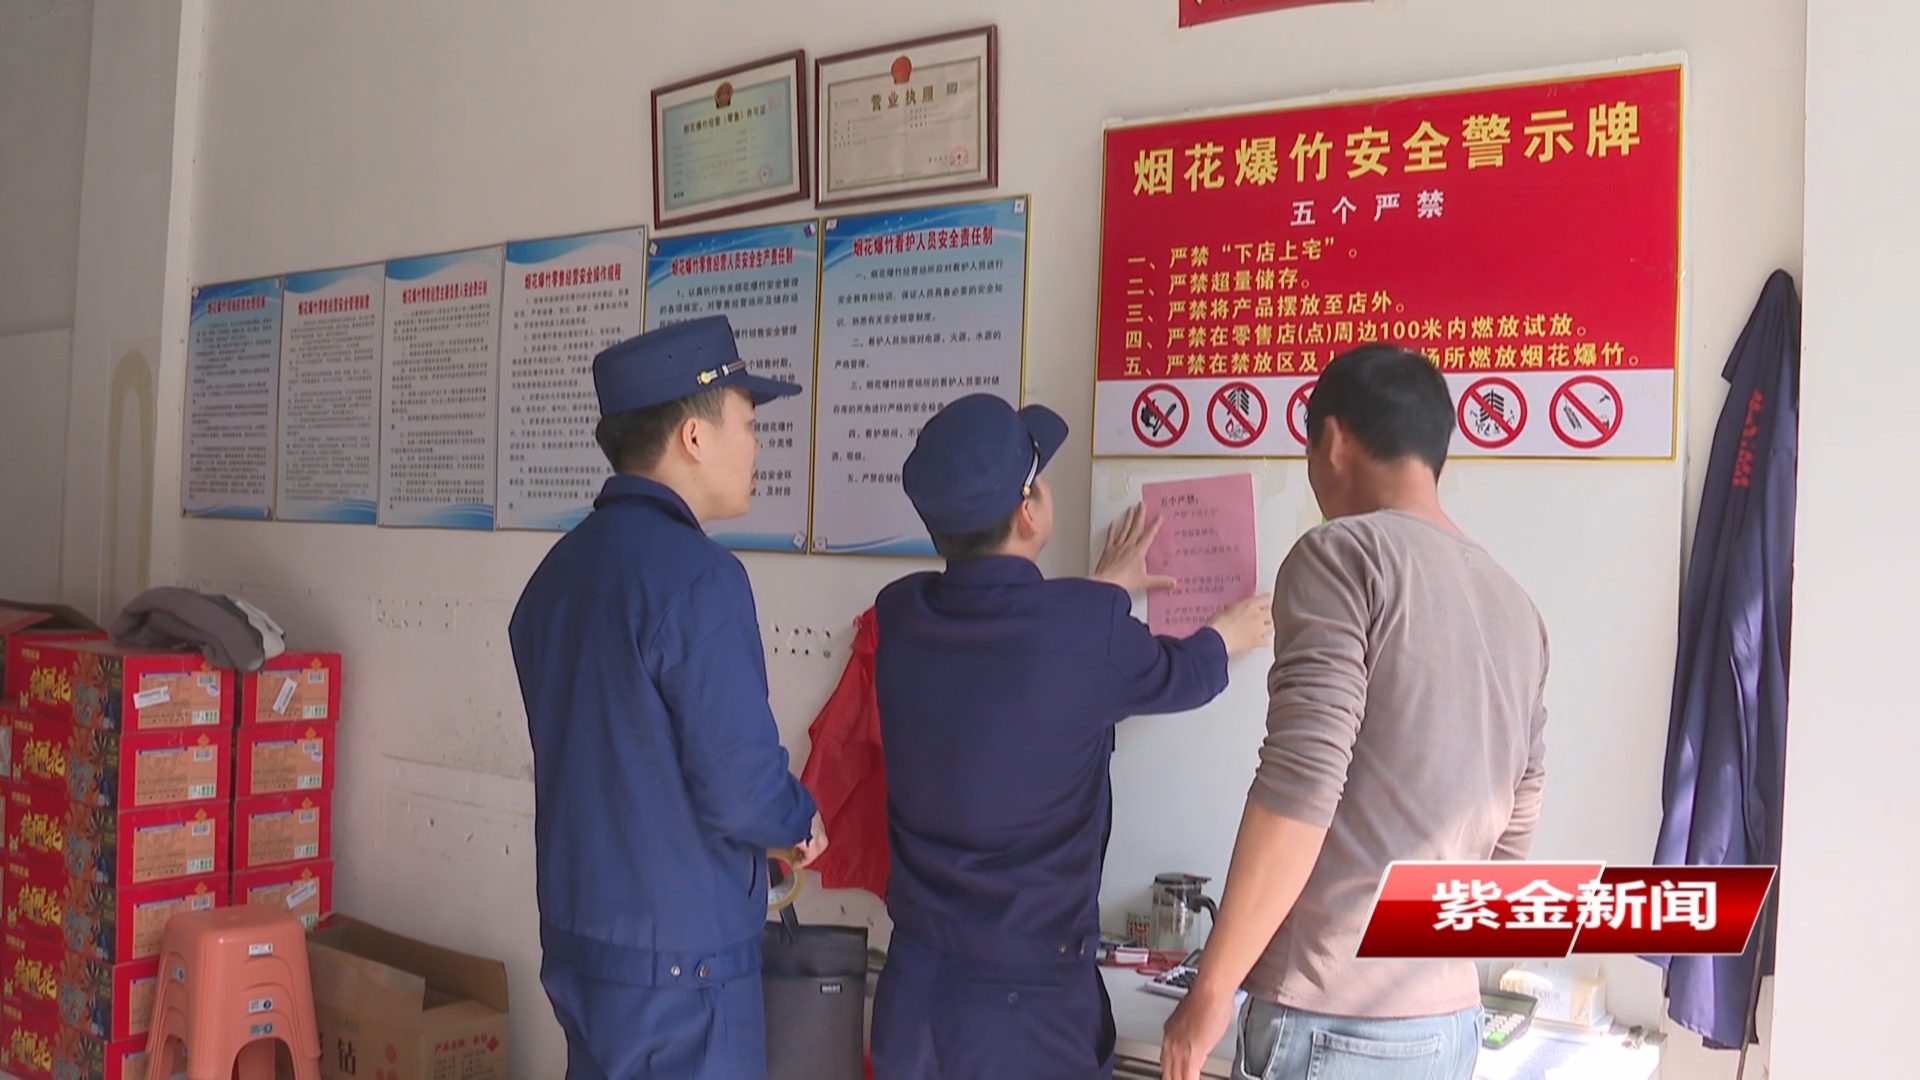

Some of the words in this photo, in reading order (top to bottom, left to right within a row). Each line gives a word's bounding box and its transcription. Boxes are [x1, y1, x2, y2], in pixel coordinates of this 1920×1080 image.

[871, 85, 934, 112] 营业执照
[1132, 101, 1641, 197] 烟花爆竹安全警示牌
[1289, 189, 1445, 227] 五个严禁
[853, 225, 994, 257] 烟花爆竹看护人员安全责任制
[671, 246, 794, 277] 烟花爆竹零售经营人员安全生产责任制
[1127, 267, 1311, 297] 二、严禁超量储存。
[1125, 290, 1406, 323] 三、严禁将产品摆放至店外。
